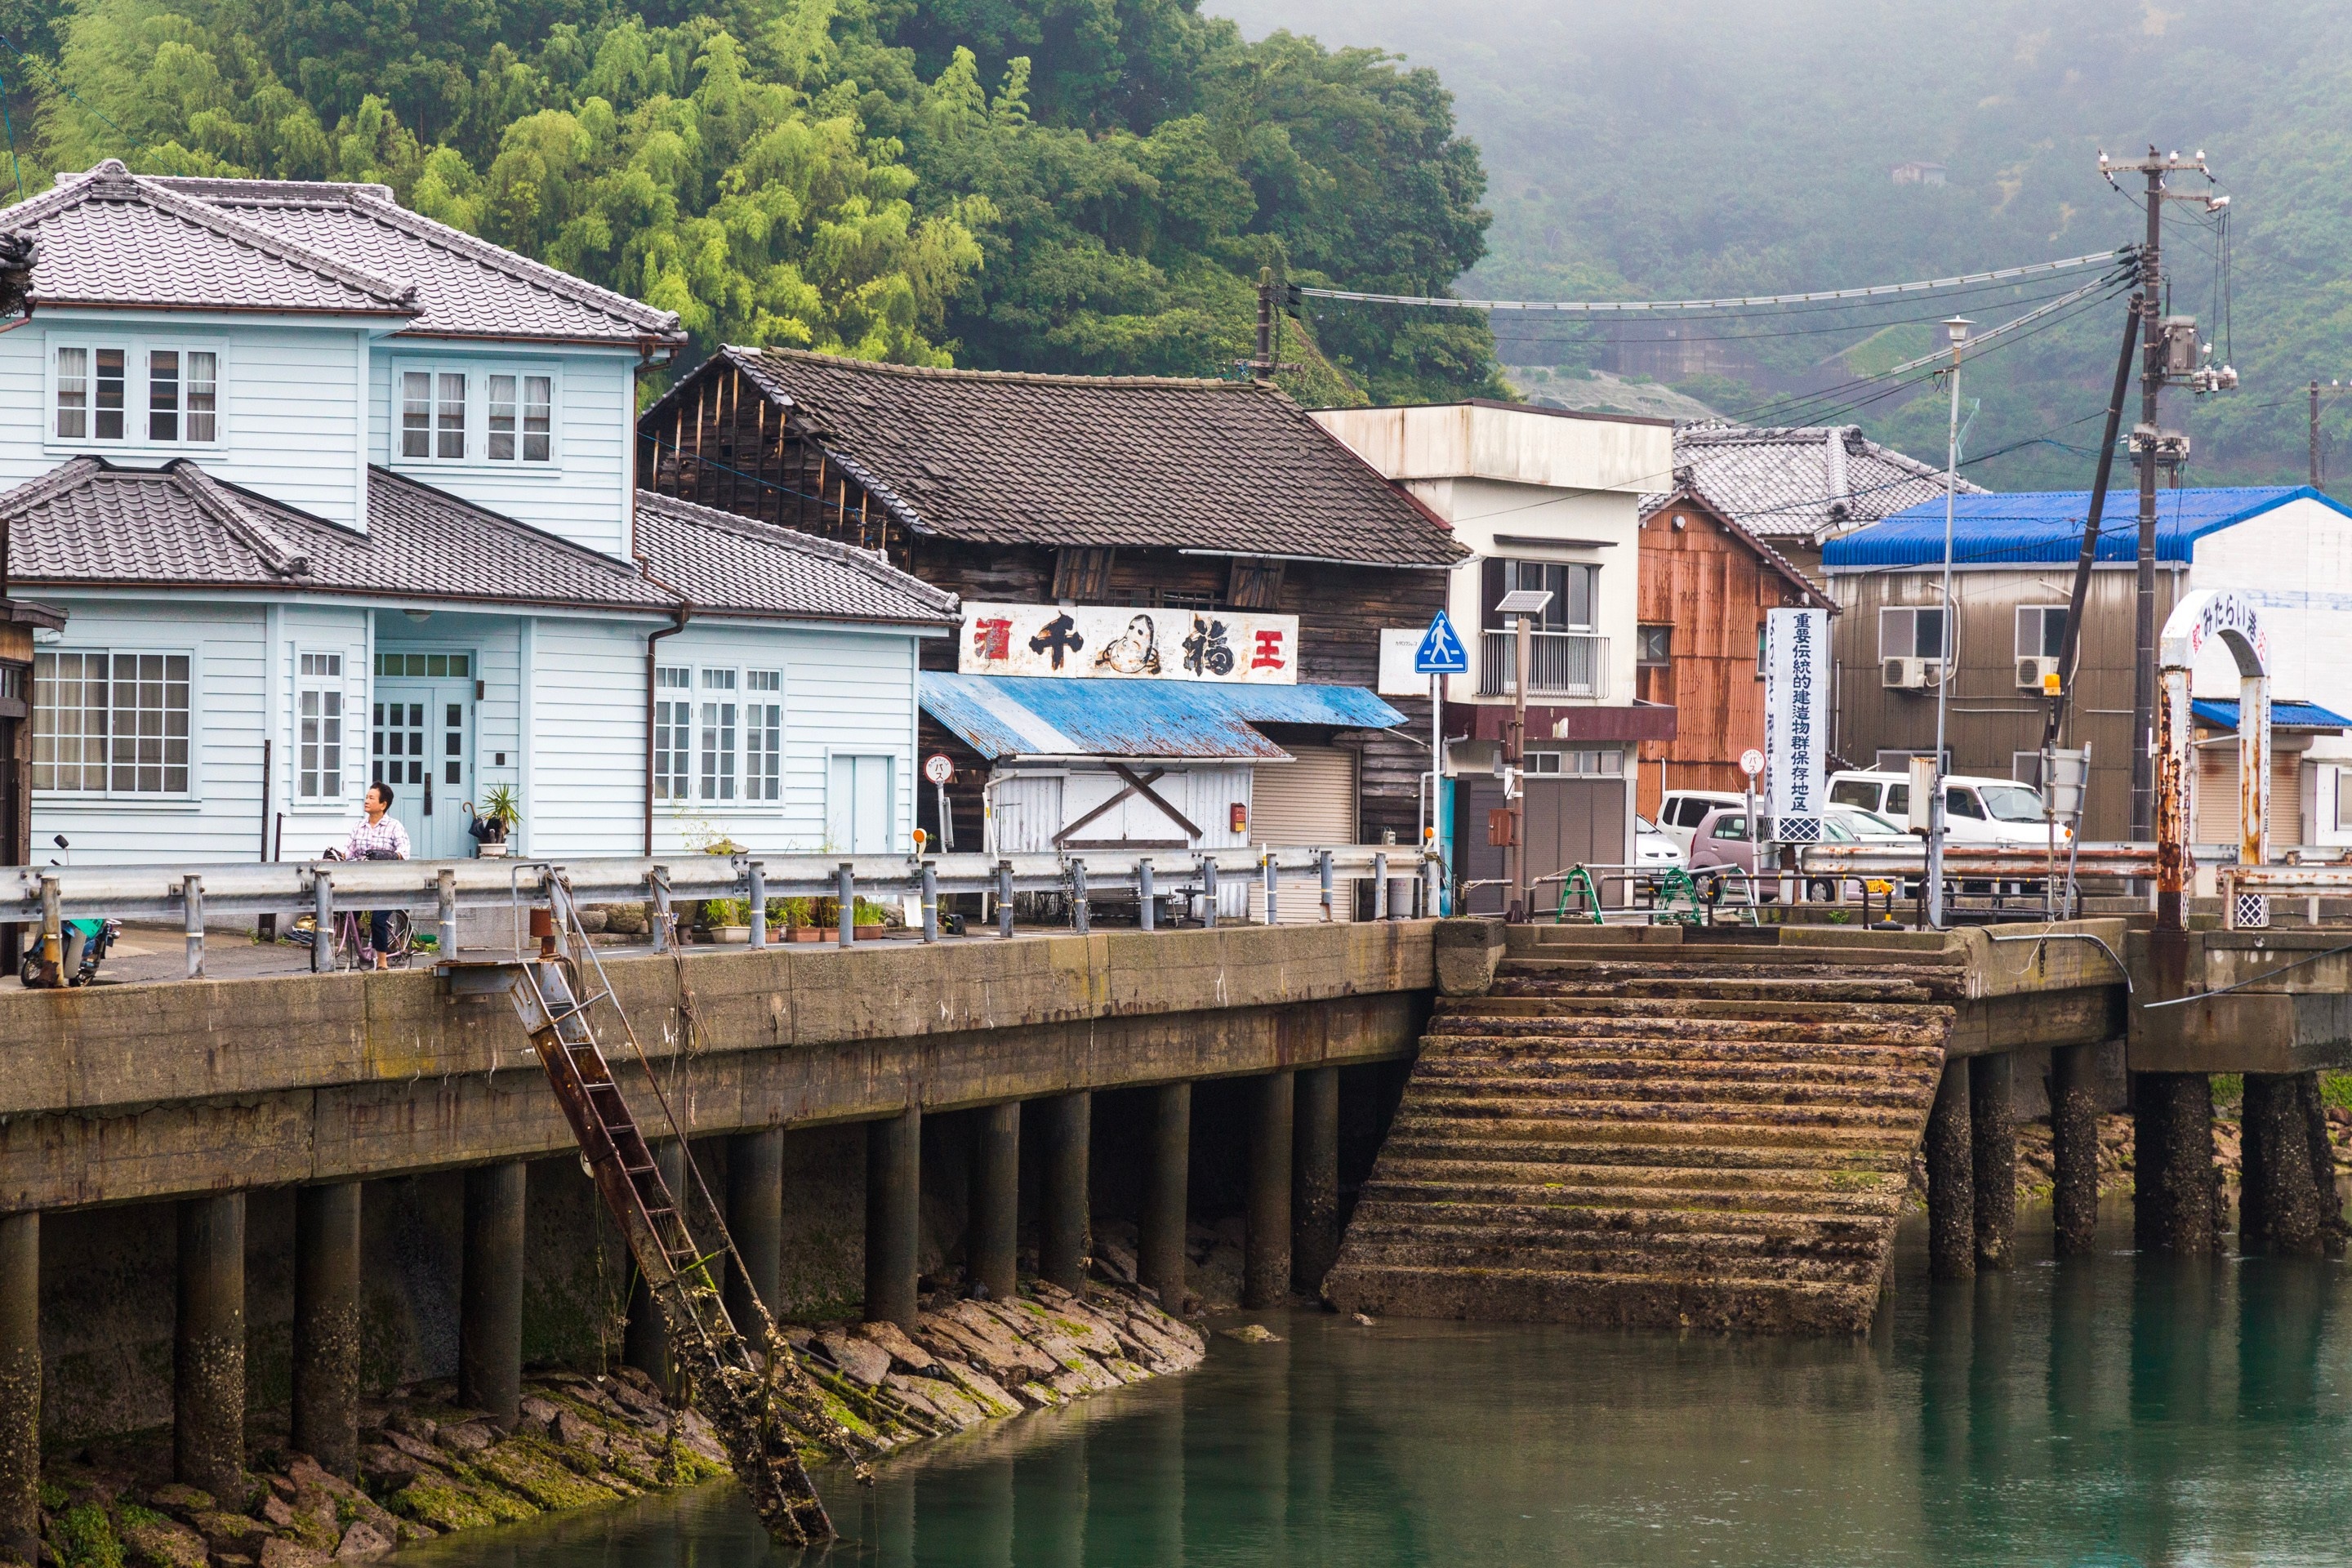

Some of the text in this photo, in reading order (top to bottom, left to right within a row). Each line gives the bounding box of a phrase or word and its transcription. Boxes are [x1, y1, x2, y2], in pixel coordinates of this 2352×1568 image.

[2203, 594, 2256, 643] みたらい港
[1252, 630, 1285, 670] 王
[1791, 613, 1811, 811] 重要伝統的建造物群保存地区
[935, 763, 943, 780] バス
[1748, 756, 1757, 772] バス
